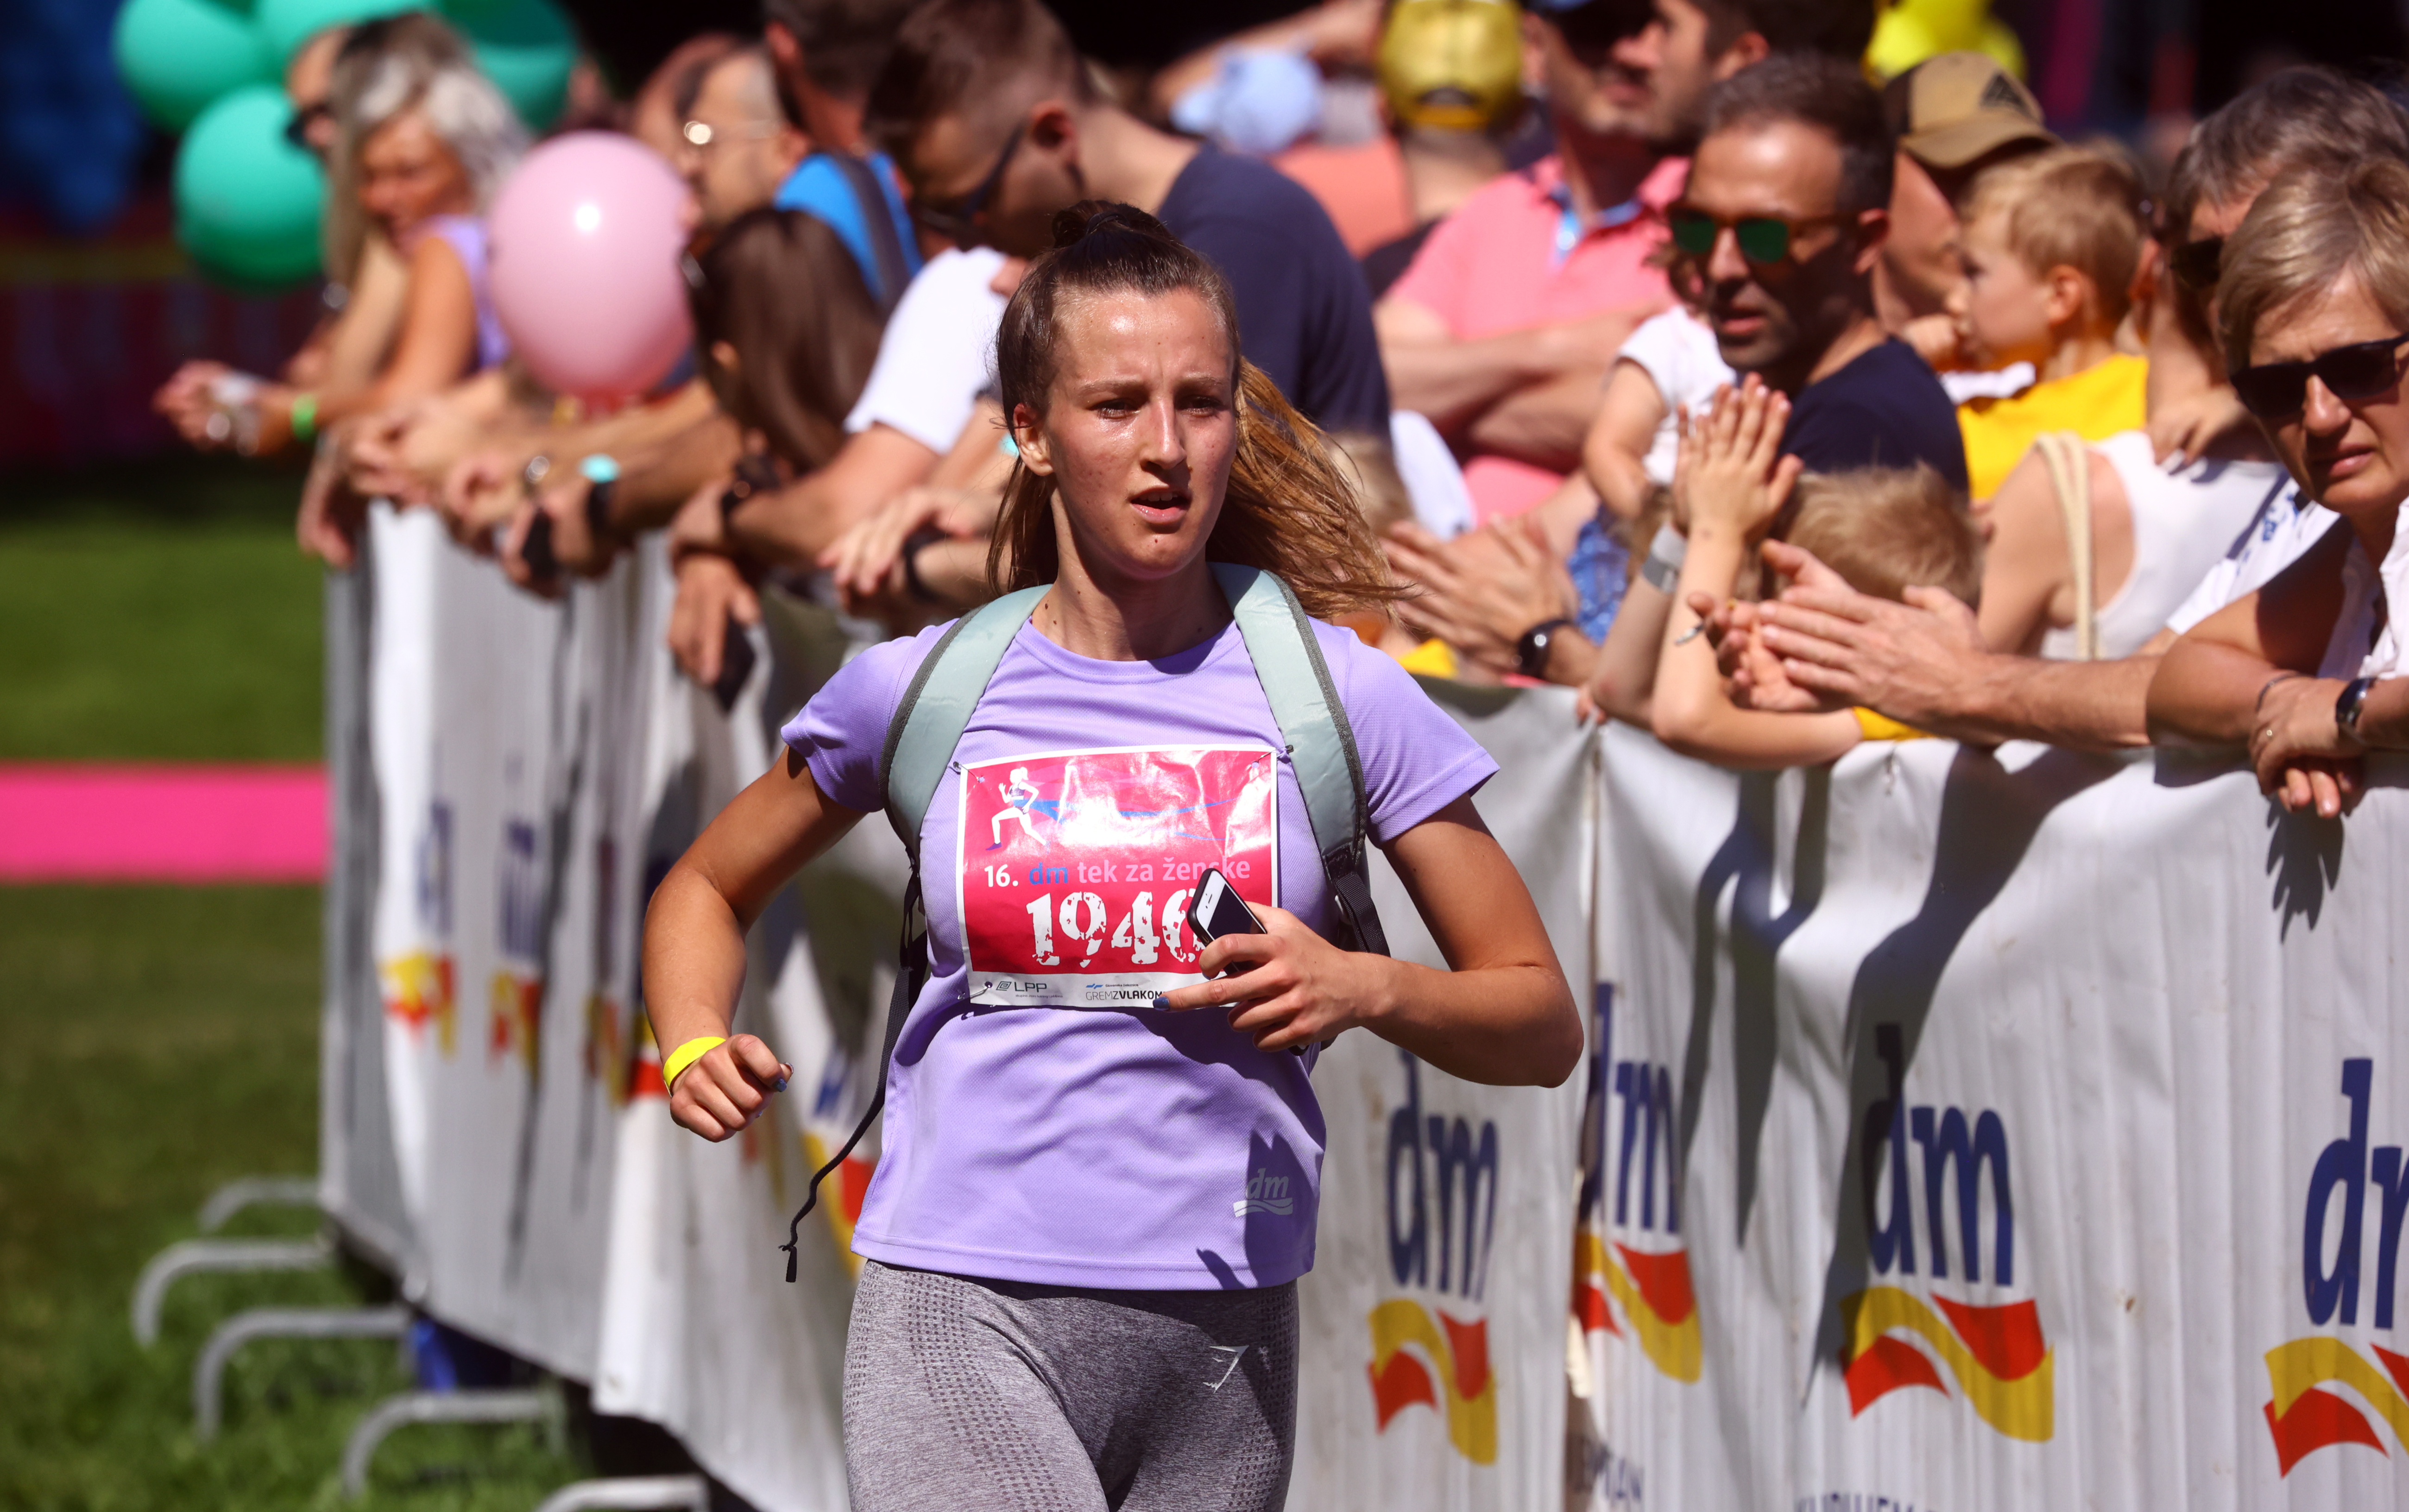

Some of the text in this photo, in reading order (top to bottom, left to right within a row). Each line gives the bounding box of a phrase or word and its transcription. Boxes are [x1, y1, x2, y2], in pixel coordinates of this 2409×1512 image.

[984, 864, 1018, 887] 16.
[1029, 862, 1068, 885] dm
[1077, 859, 1118, 883] tek
[1125, 864, 1153, 882] za
[1014, 981, 1047, 992] LPP
[1861, 1024, 2013, 1287] dm
[1245, 1167, 1289, 1199] dm
[1385, 1047, 1499, 1303] dm
